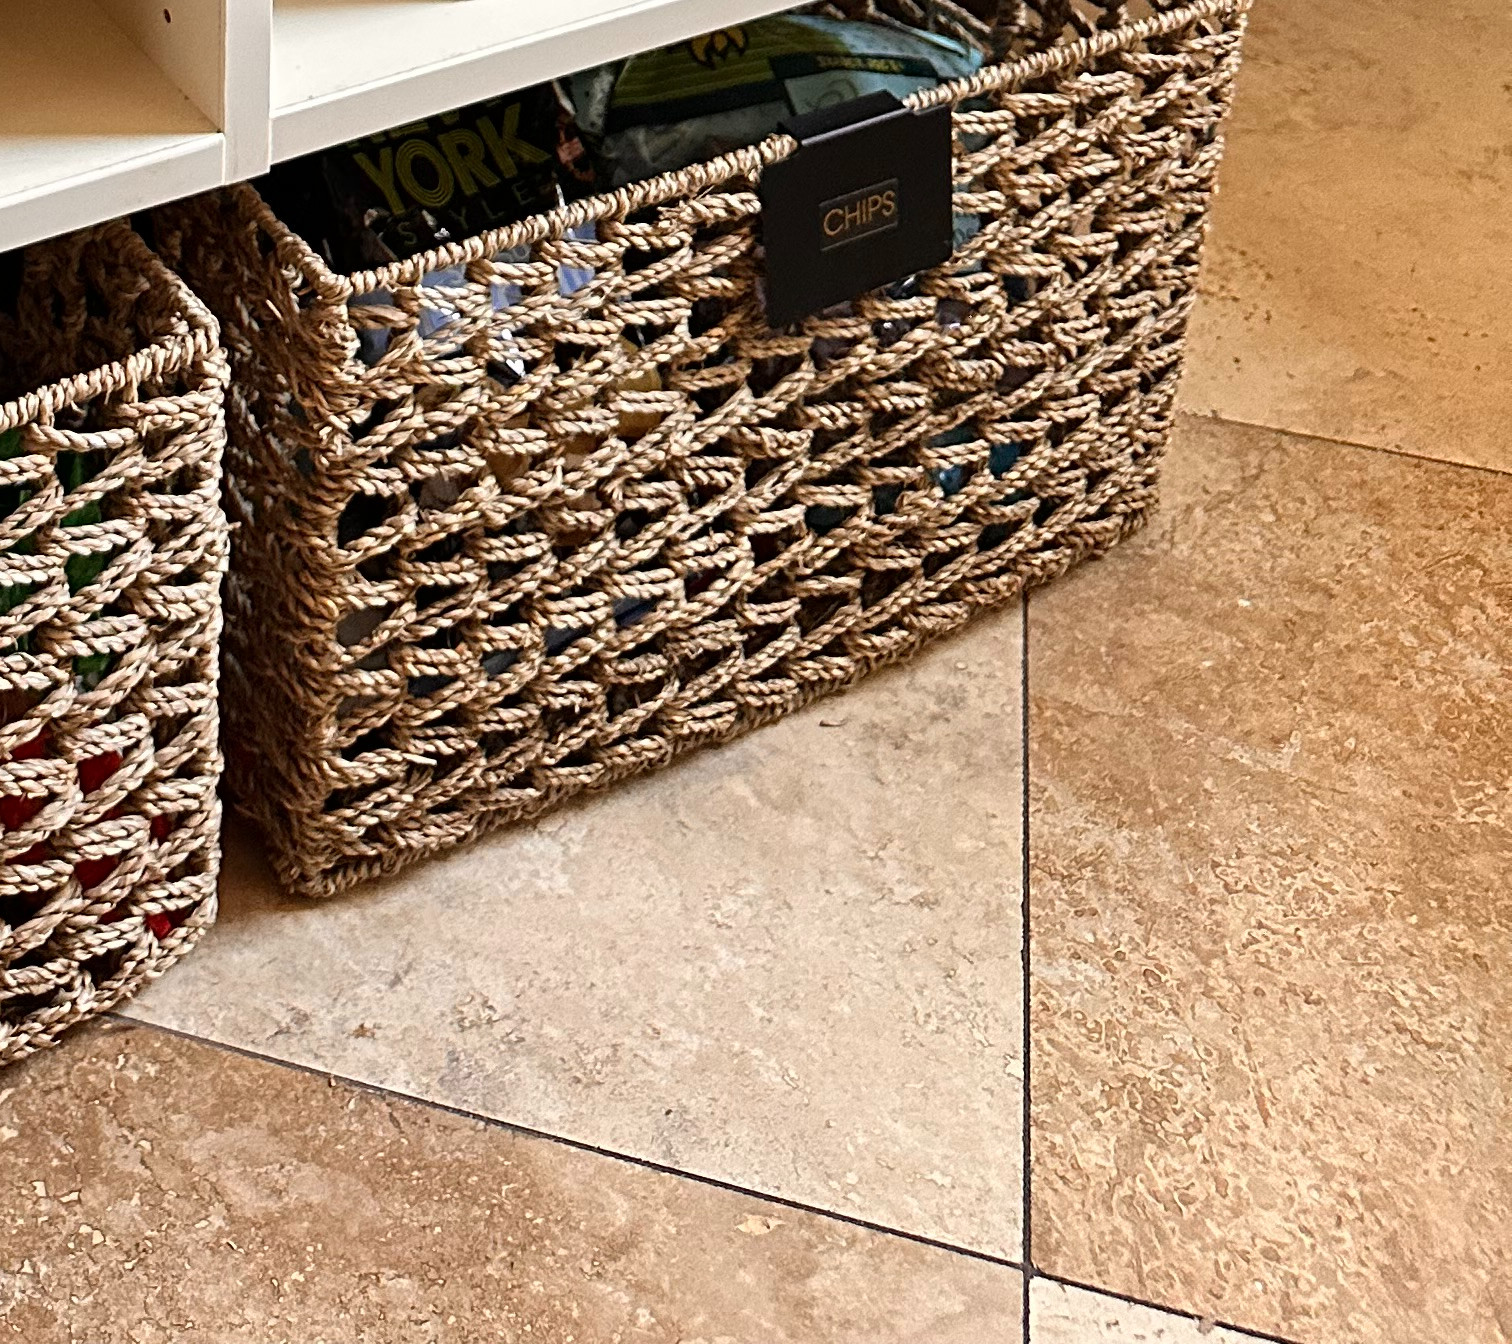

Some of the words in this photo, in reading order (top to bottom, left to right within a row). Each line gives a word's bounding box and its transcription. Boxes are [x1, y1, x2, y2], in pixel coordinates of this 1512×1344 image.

[352, 102, 552, 216] YORK
[396, 176, 540, 247] SYLE
[823, 190, 896, 236] CHIPS
